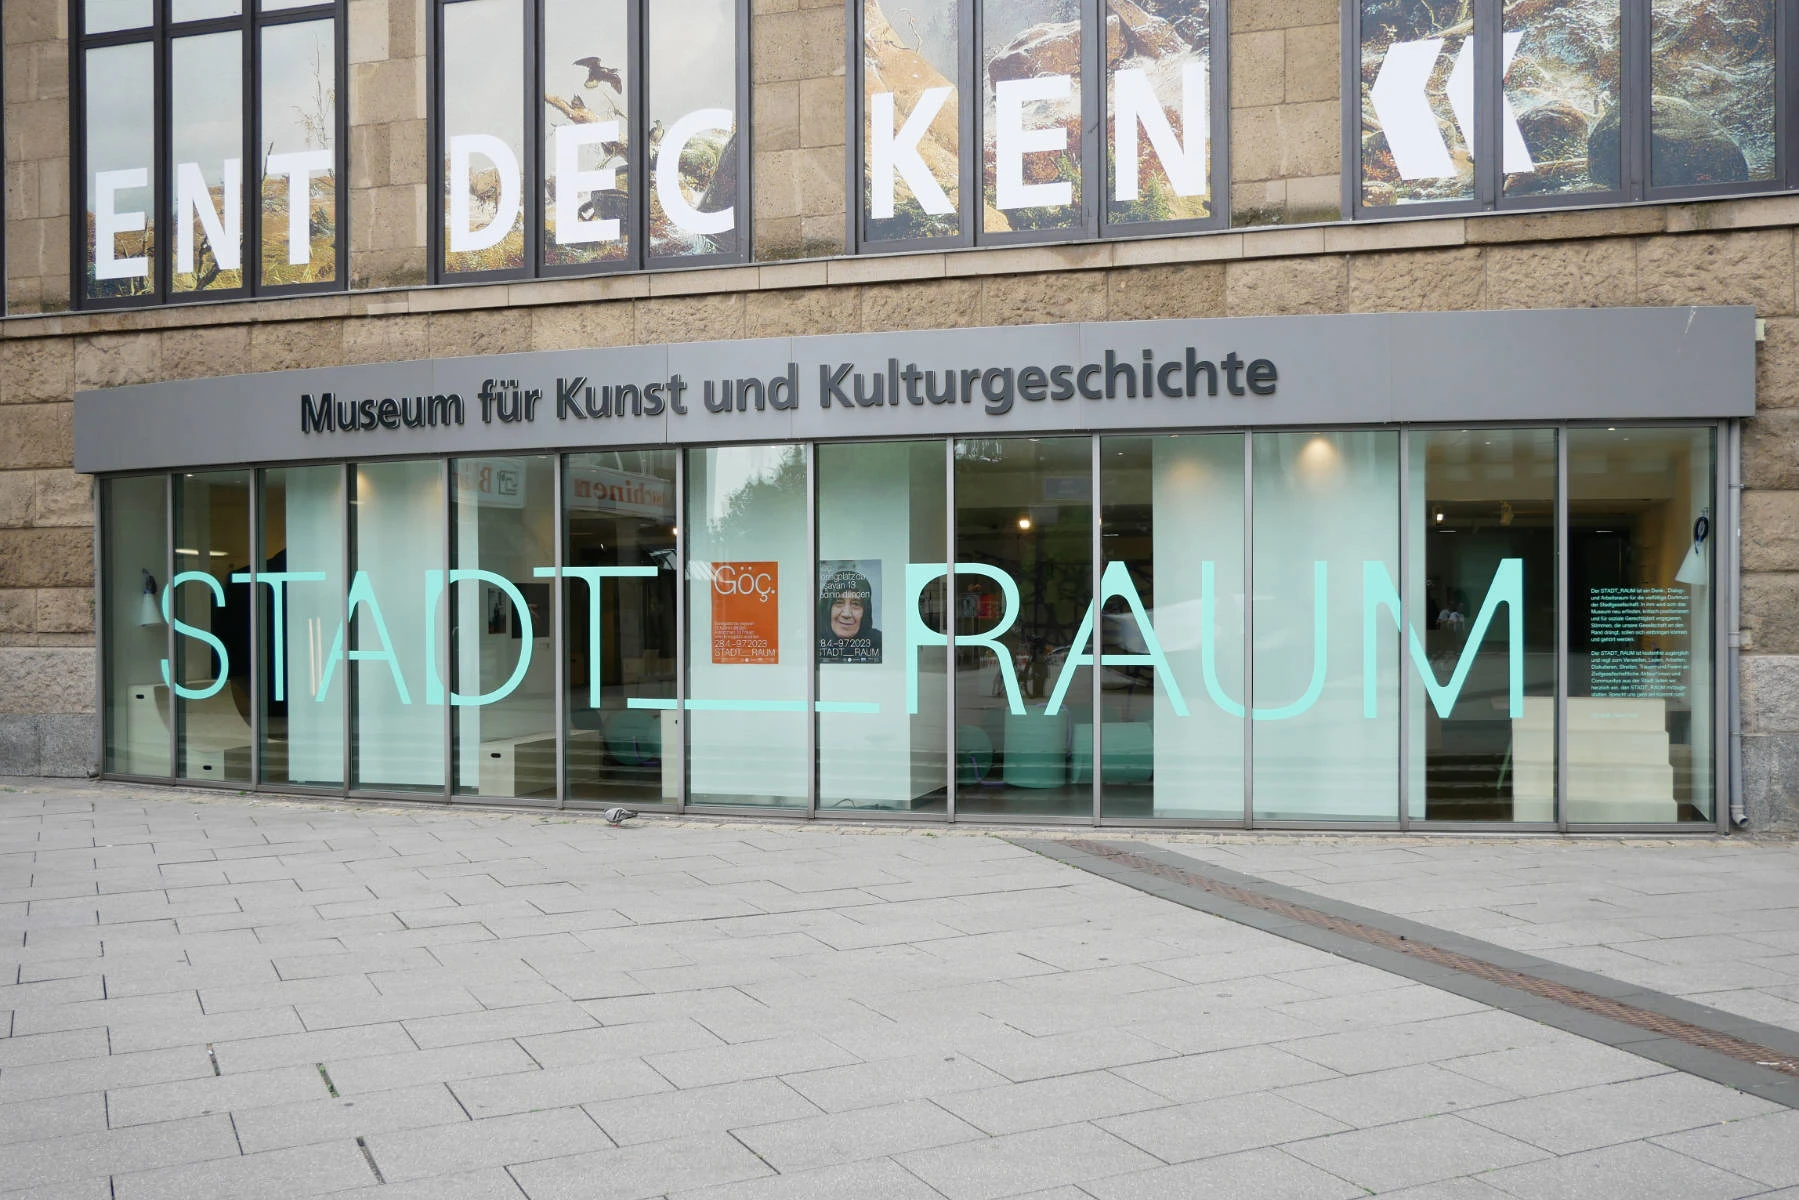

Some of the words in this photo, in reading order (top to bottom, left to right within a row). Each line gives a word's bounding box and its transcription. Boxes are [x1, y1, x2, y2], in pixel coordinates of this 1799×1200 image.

[300, 391, 464, 433] Museum
[478, 379, 542, 423] für
[556, 372, 687, 420] Kunst
[703, 362, 799, 414] und
[818, 346, 1278, 416] Kulturgeschichte
[714, 565, 776, 603] Göç.
